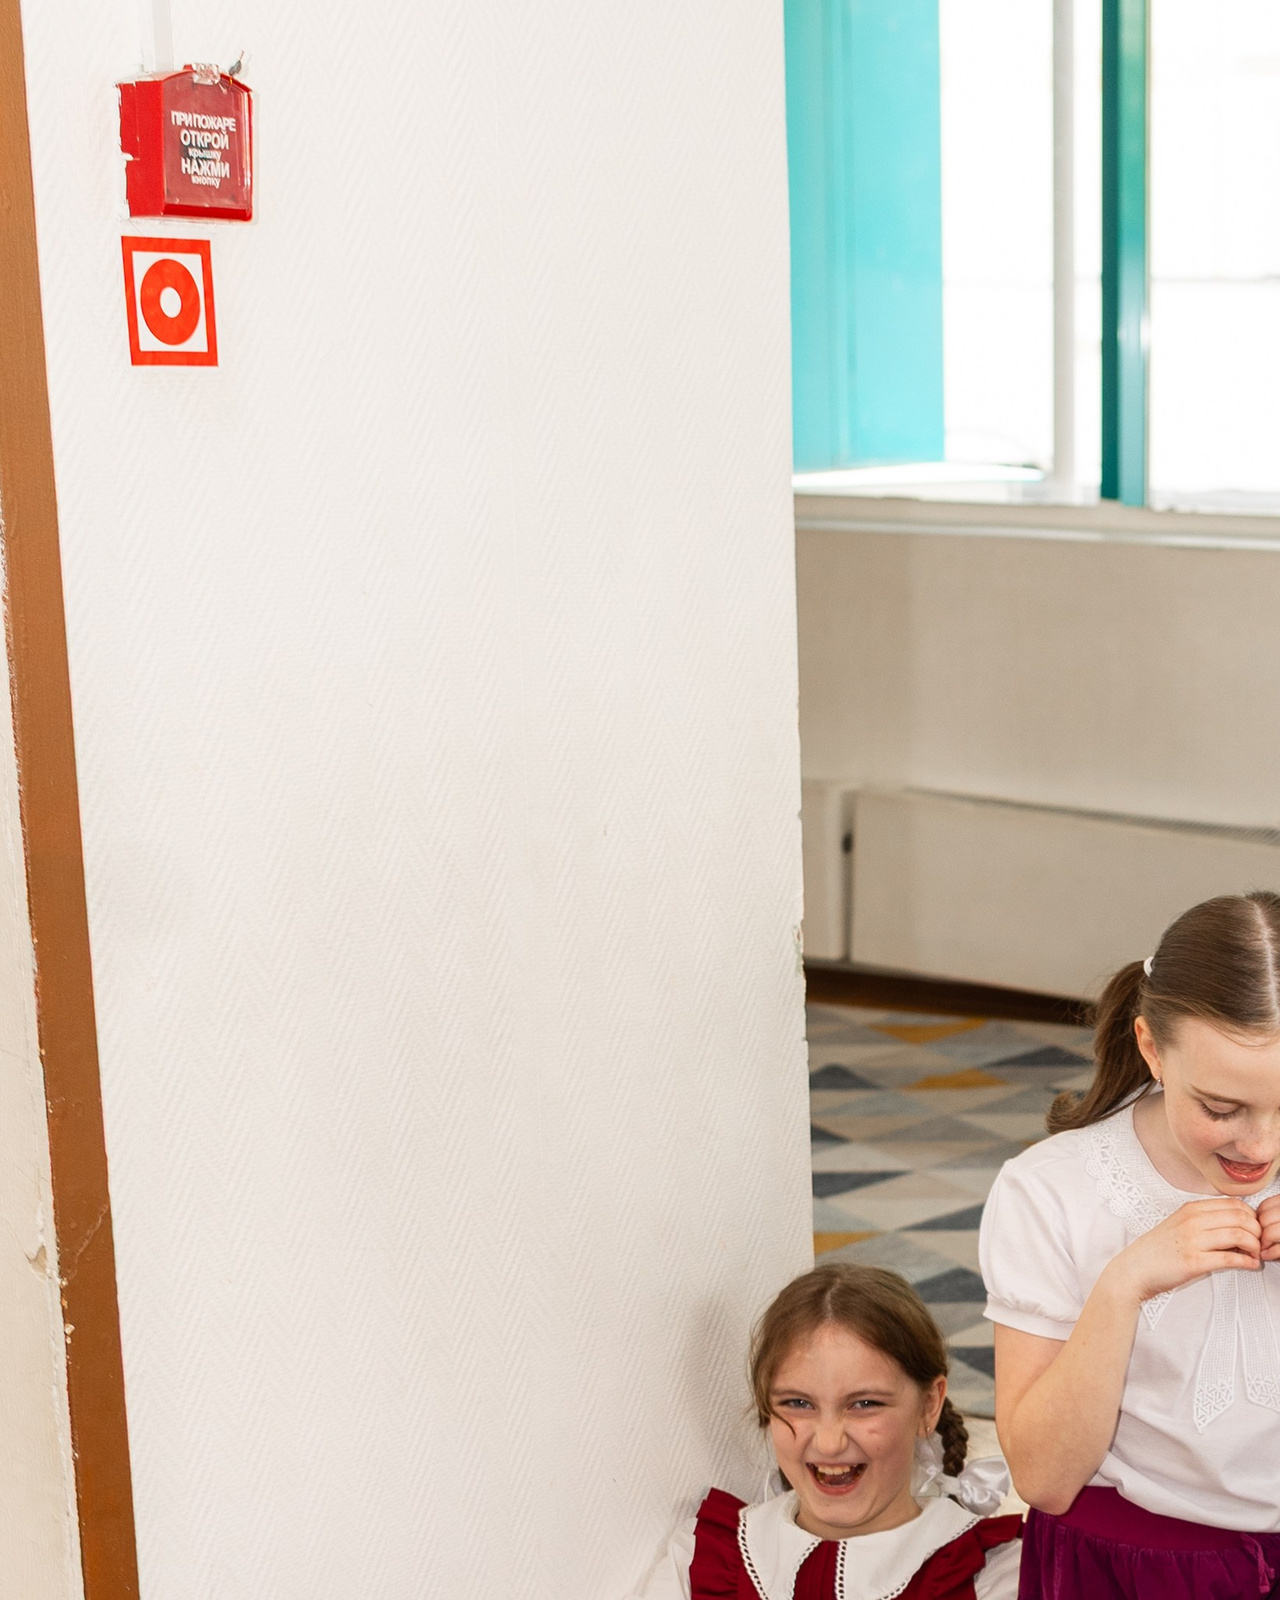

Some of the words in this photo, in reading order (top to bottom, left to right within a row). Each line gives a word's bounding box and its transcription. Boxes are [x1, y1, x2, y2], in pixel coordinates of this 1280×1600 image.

[171, 111, 193, 127] ПРИ
[193, 113, 236, 132] ПОЖАРЕ
[180, 129, 229, 150] ОТКРОЙ
[181, 157, 230, 179] НАЖМИ
